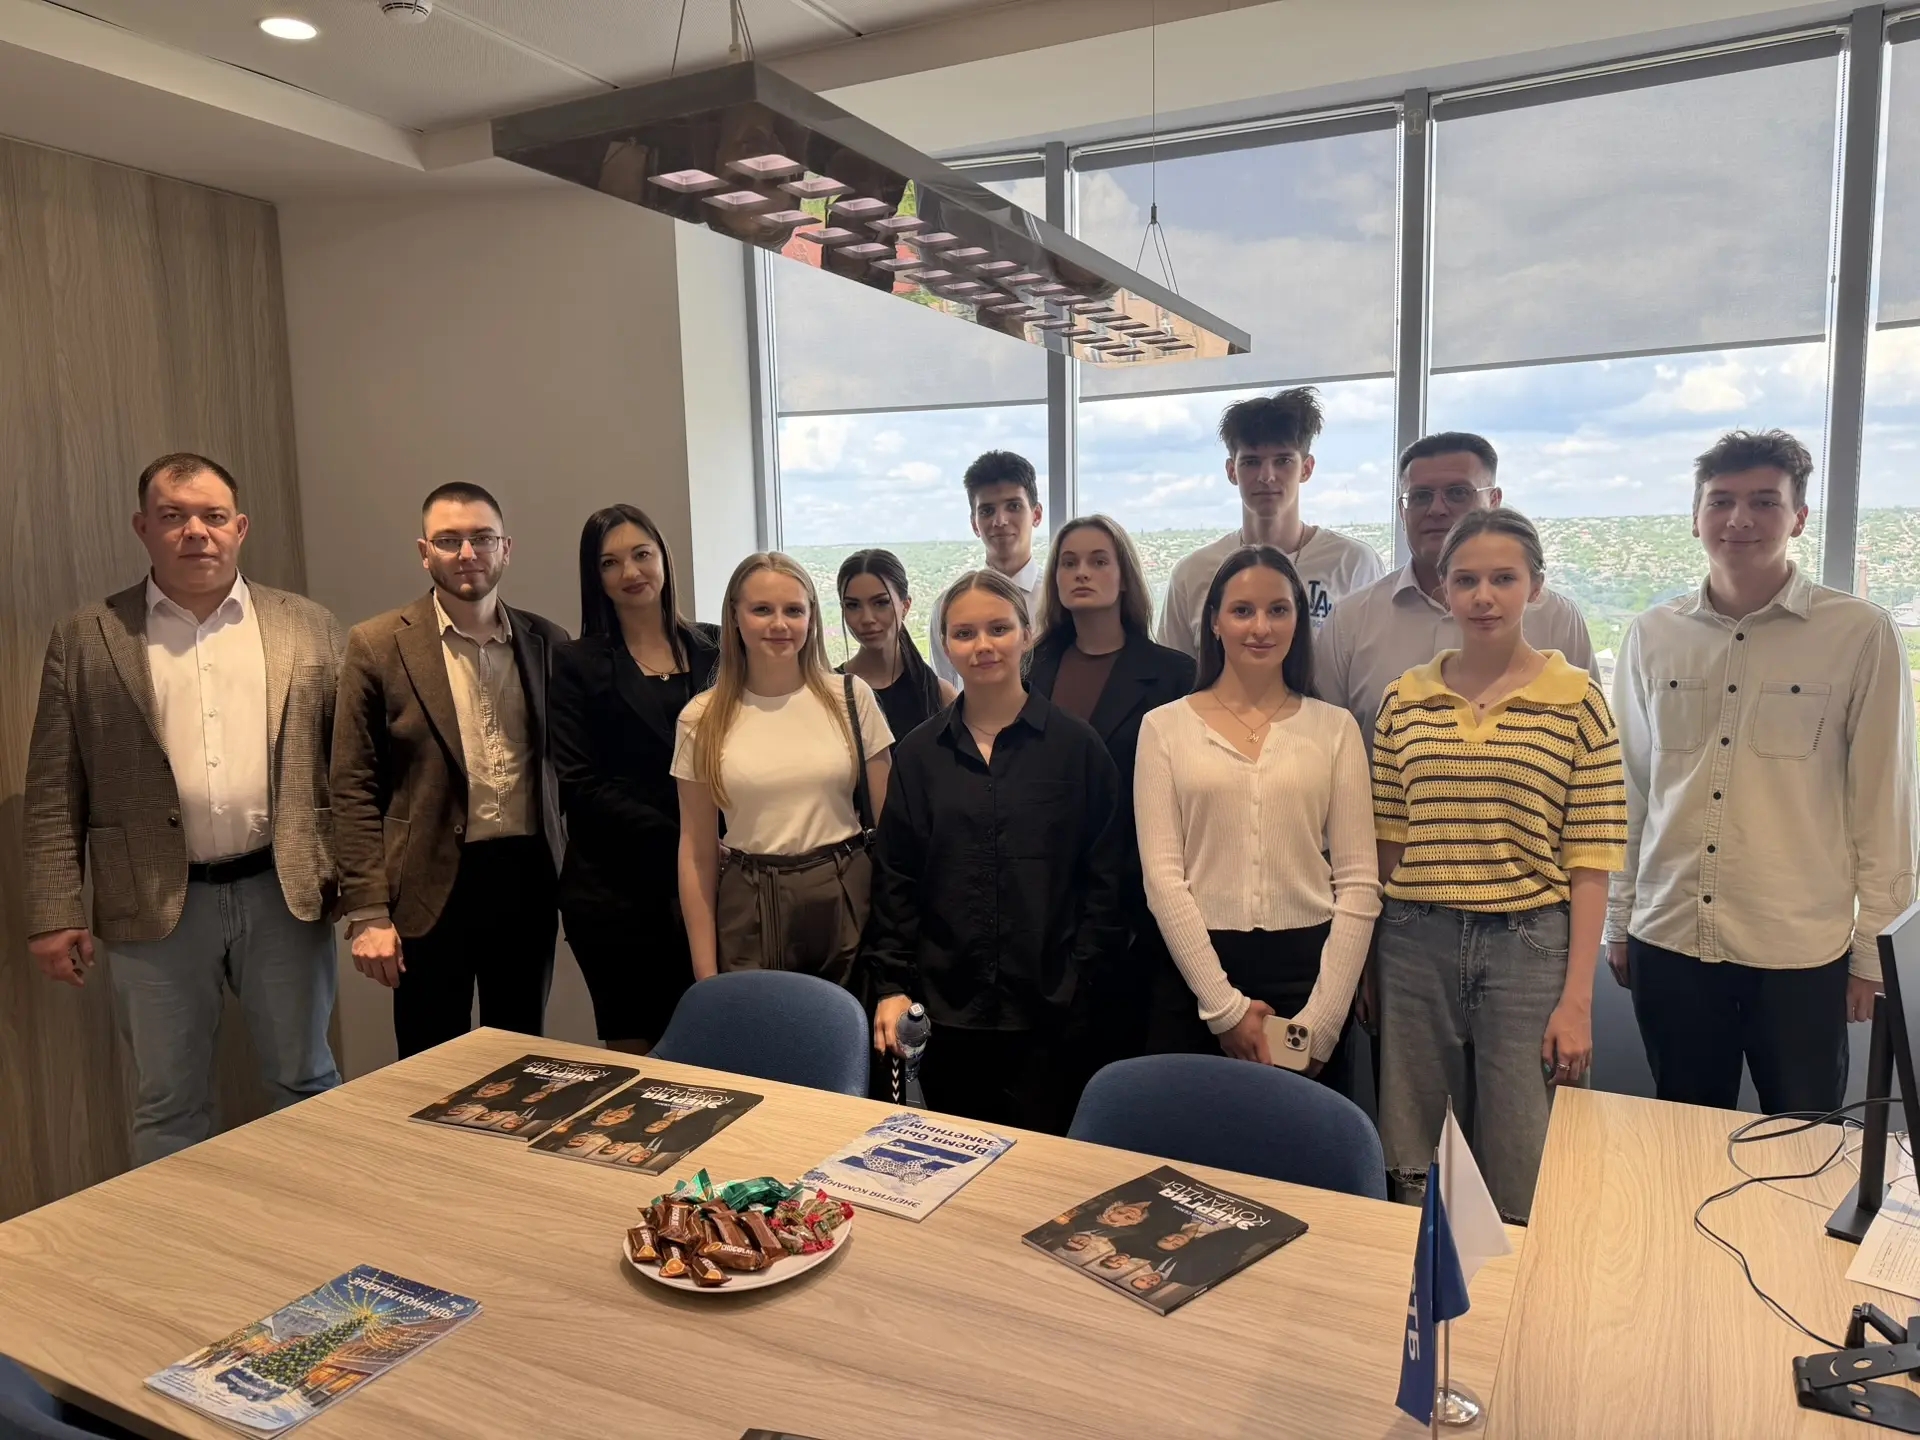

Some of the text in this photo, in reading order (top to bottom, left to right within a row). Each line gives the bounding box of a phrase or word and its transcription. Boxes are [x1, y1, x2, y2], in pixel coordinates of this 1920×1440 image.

[523, 1066, 599, 1082] ЭНЕРГИЯ
[641, 1091, 722, 1109] ЭНЕРГИЯ
[645, 1085, 734, 1105] КОМАНДЫ
[887, 1125, 989, 1155] Время быть
[908, 1121, 998, 1147] заметным
[868, 1190, 921, 1209] ЭНЕРГИЯ
[1158, 1188, 1255, 1230] ЭНЕРГИЯ
[1163, 1180, 1271, 1227] КОМАНДЫ
[349, 1277, 399, 1299] ЭНЕРГИЯ
[396, 1293, 456, 1319] КОМАНДЫ
